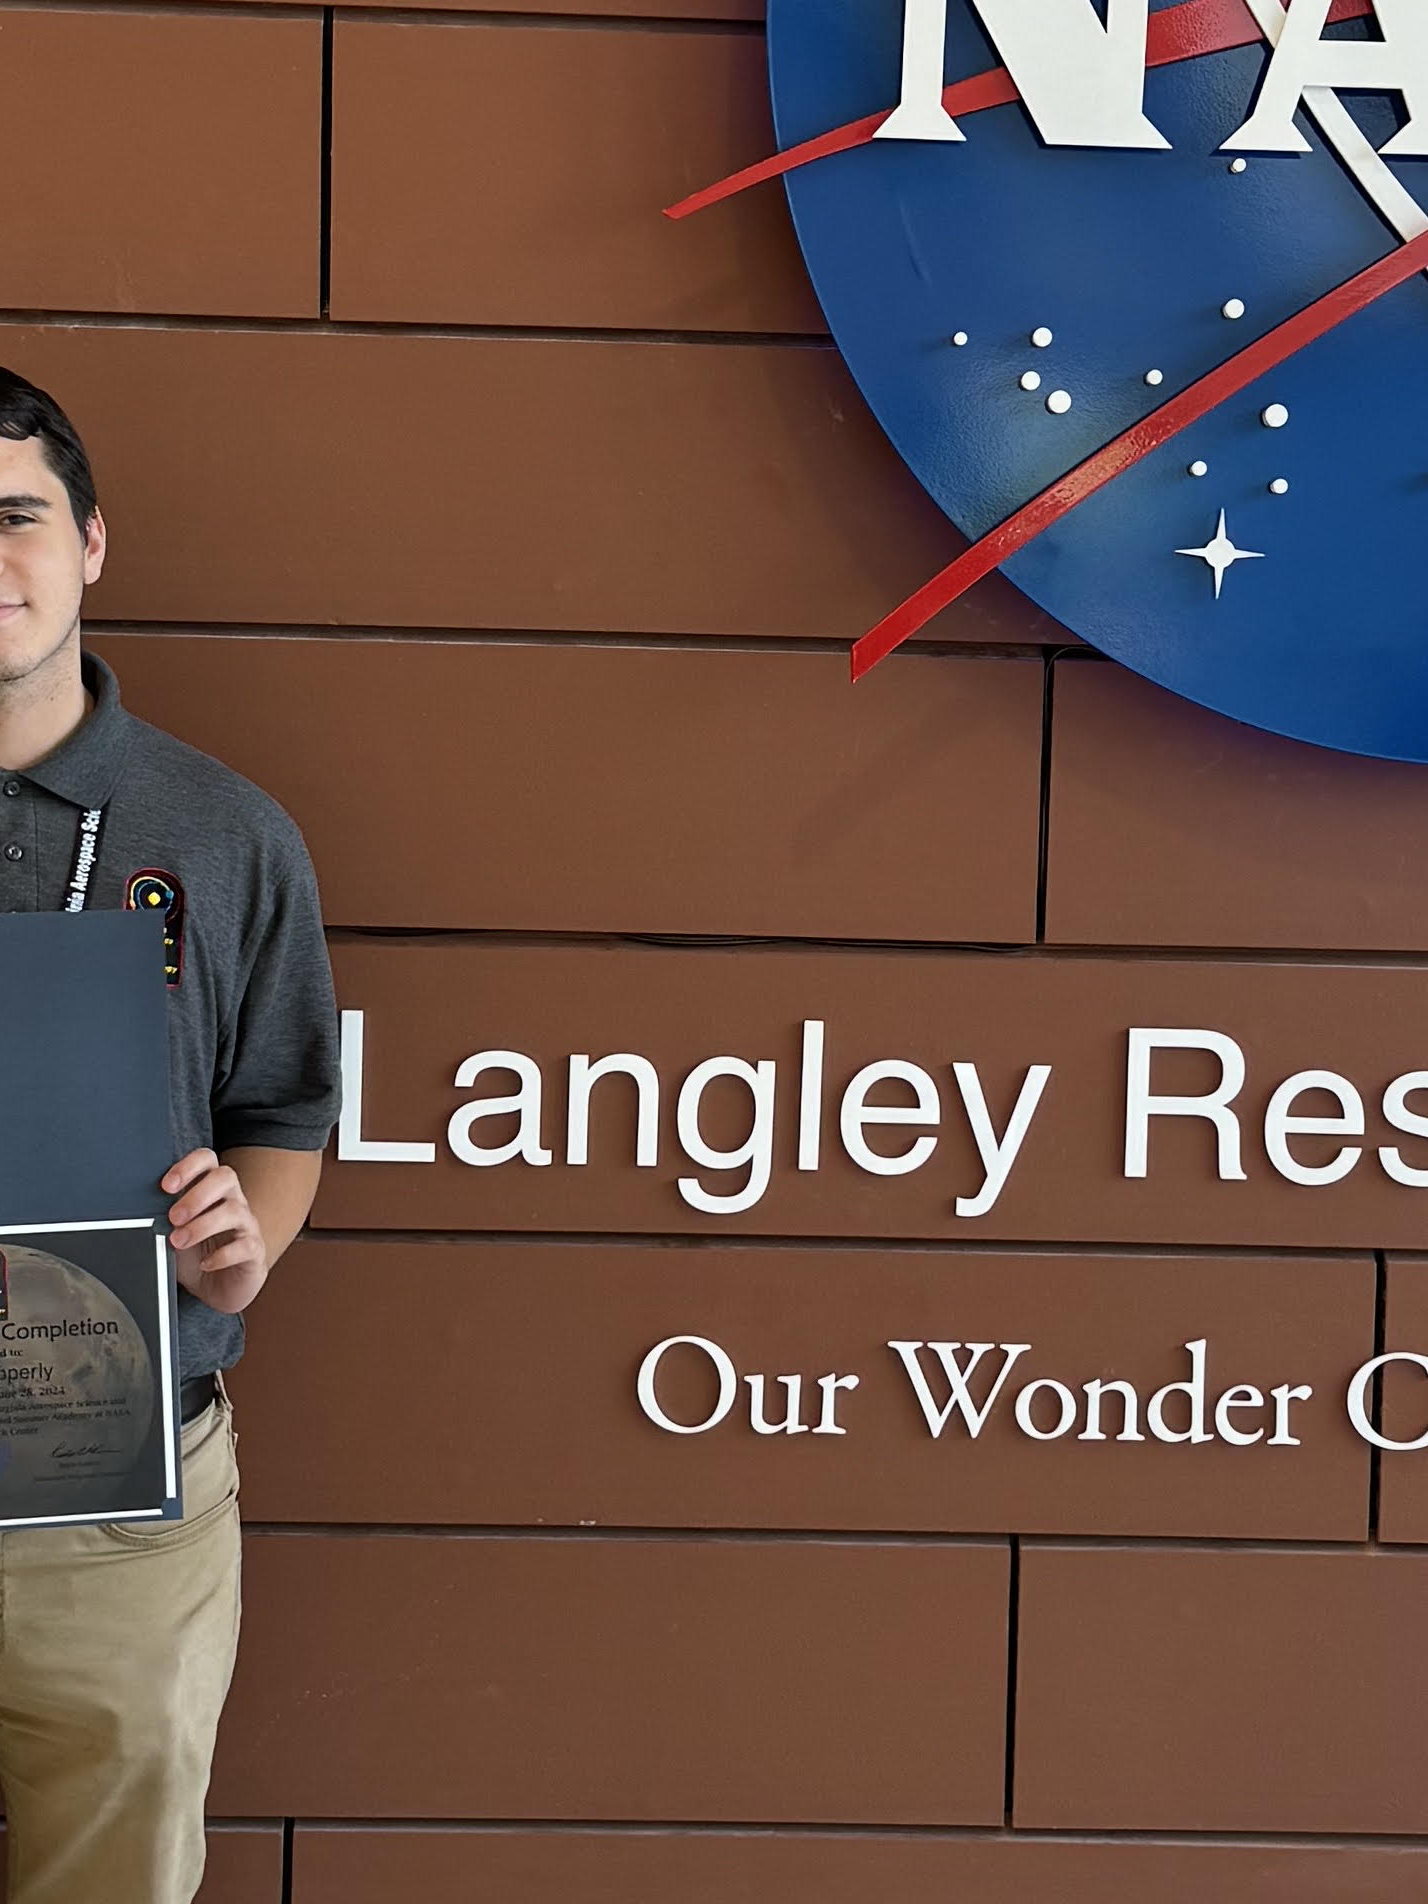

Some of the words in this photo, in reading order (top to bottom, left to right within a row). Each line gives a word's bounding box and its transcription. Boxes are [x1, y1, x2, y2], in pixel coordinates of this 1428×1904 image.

[70, 833, 97, 892] Aerospace
[337, 1009, 1052, 1217] Langley
[1, 1318, 120, 1343] Completion
[39, 1385, 66, 1396] 2024
[637, 1335, 860, 1435] Our
[887, 1338, 1313, 1446] Wonder
